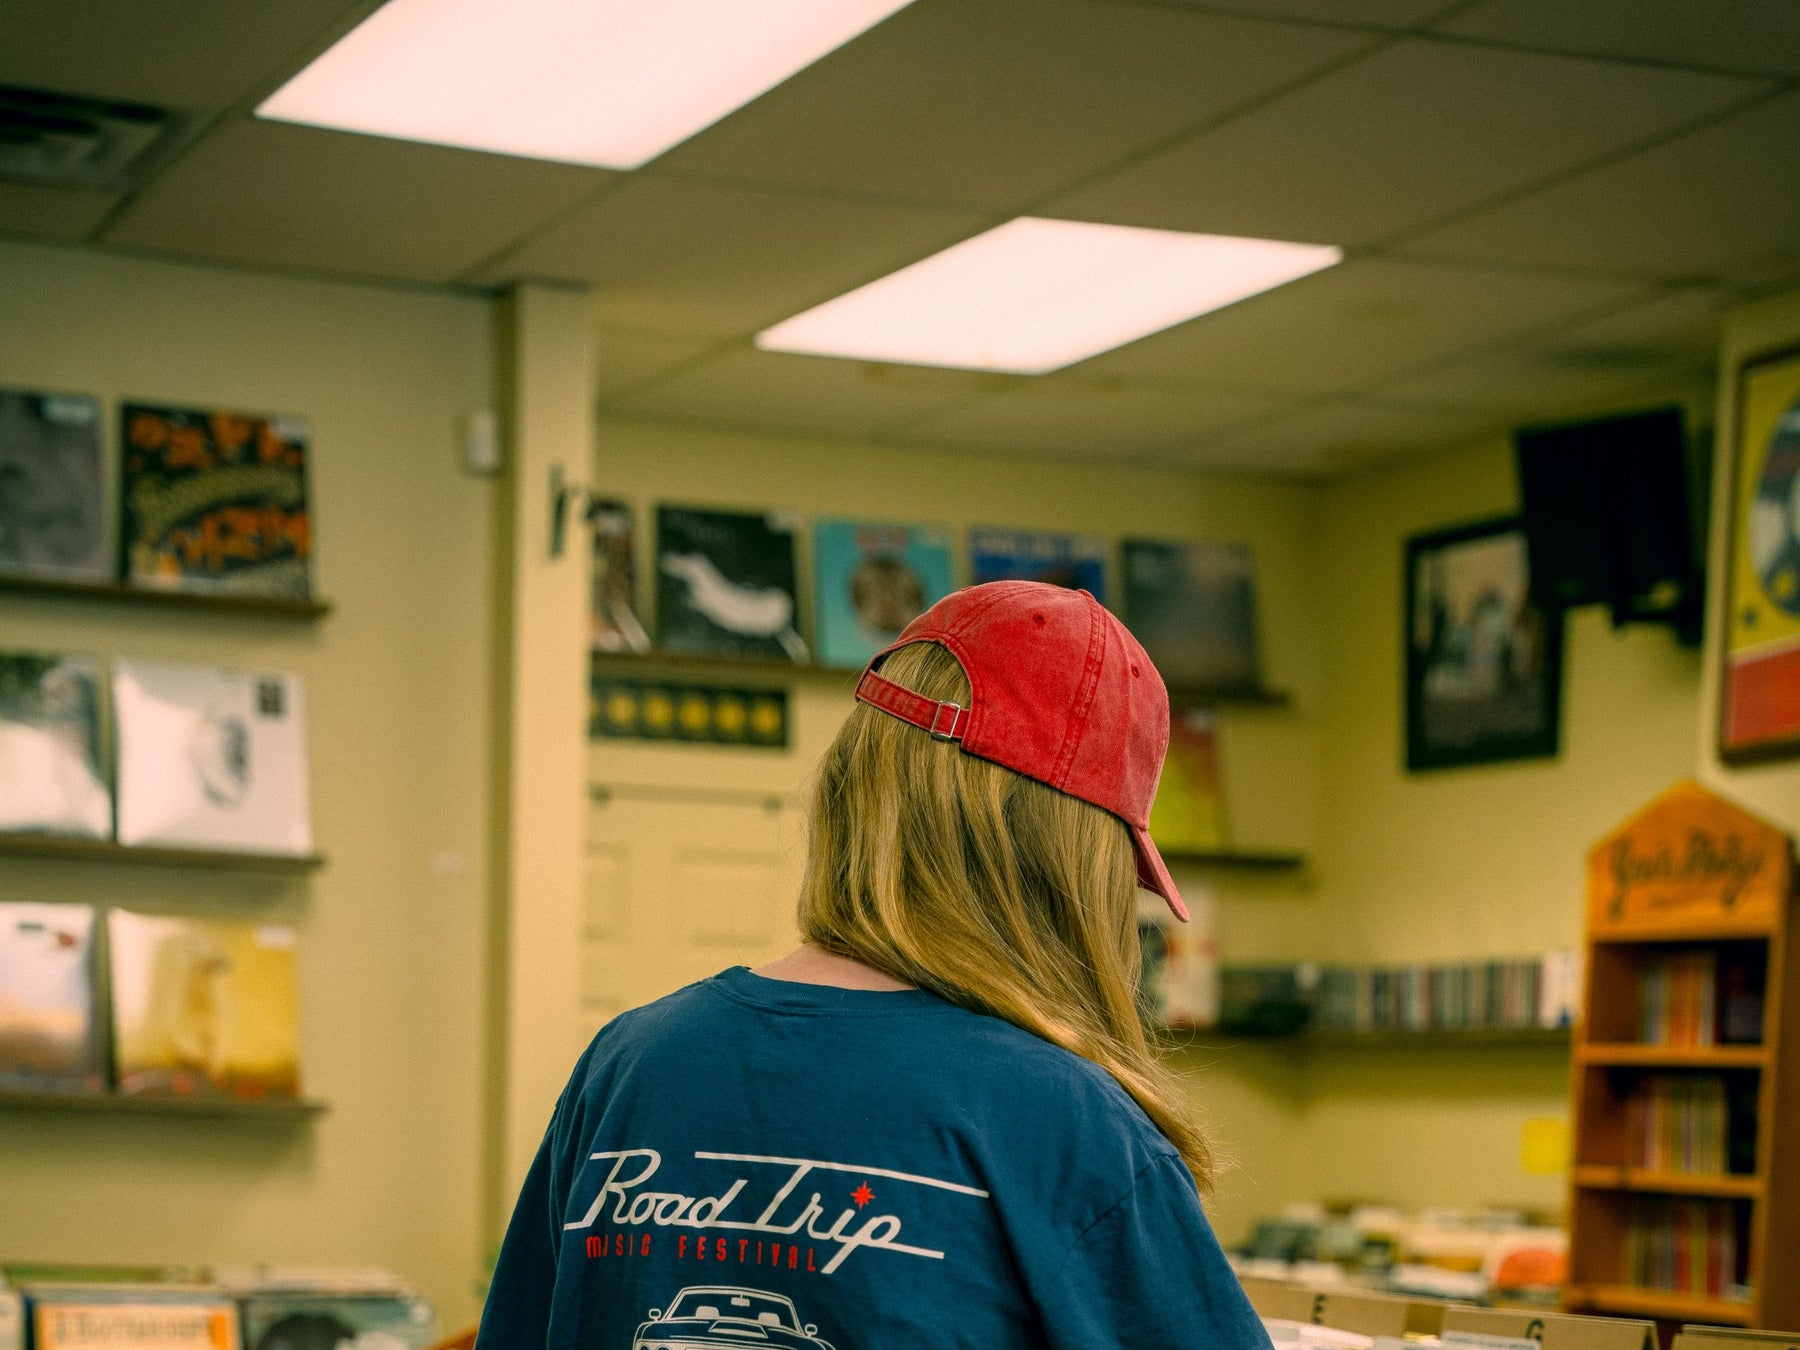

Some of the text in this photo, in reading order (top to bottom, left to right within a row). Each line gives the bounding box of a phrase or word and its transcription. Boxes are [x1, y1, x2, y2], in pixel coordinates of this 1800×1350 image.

[564, 1149, 989, 1274] Road Trip
[678, 1235, 816, 1272] FESTIVAL
